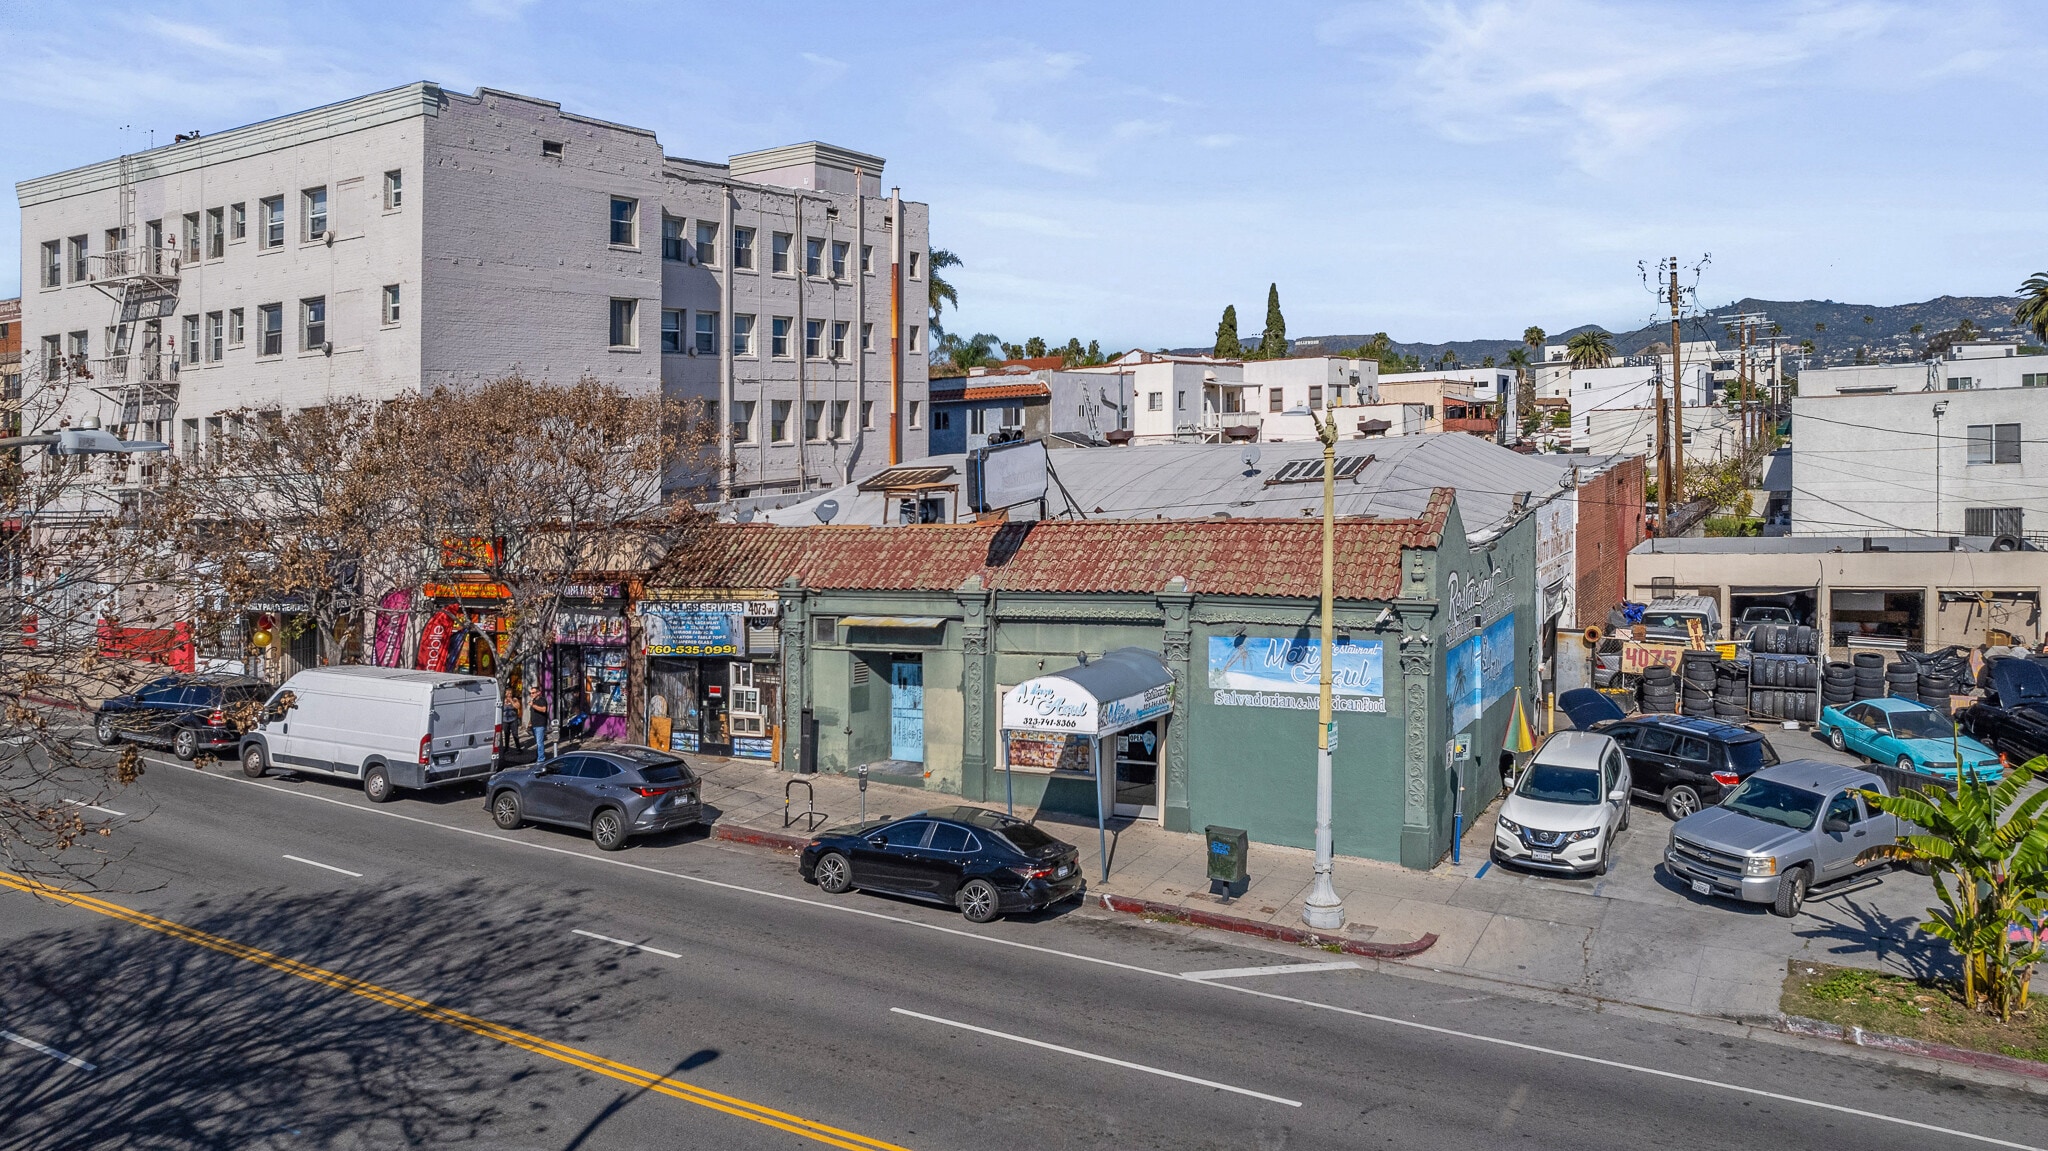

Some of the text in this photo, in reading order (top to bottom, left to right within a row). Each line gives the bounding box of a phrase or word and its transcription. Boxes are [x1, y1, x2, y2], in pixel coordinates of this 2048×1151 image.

[700, 603, 743, 612] SERVICES
[748, 602, 766, 615] 4073
[648, 645, 738, 655] 760-535-0991
[1263, 637, 1320, 670] Mar
[1625, 647, 1677, 669] 4075
[1016, 682, 1055, 705] Mar
[1213, 689, 1296, 709] Salvadorian
[1307, 698, 1362, 712] Mxican
[1362, 697, 1387, 713] Food
[1037, 697, 1088, 718] Azul
[1022, 717, 1077, 728] 323-741-8366
